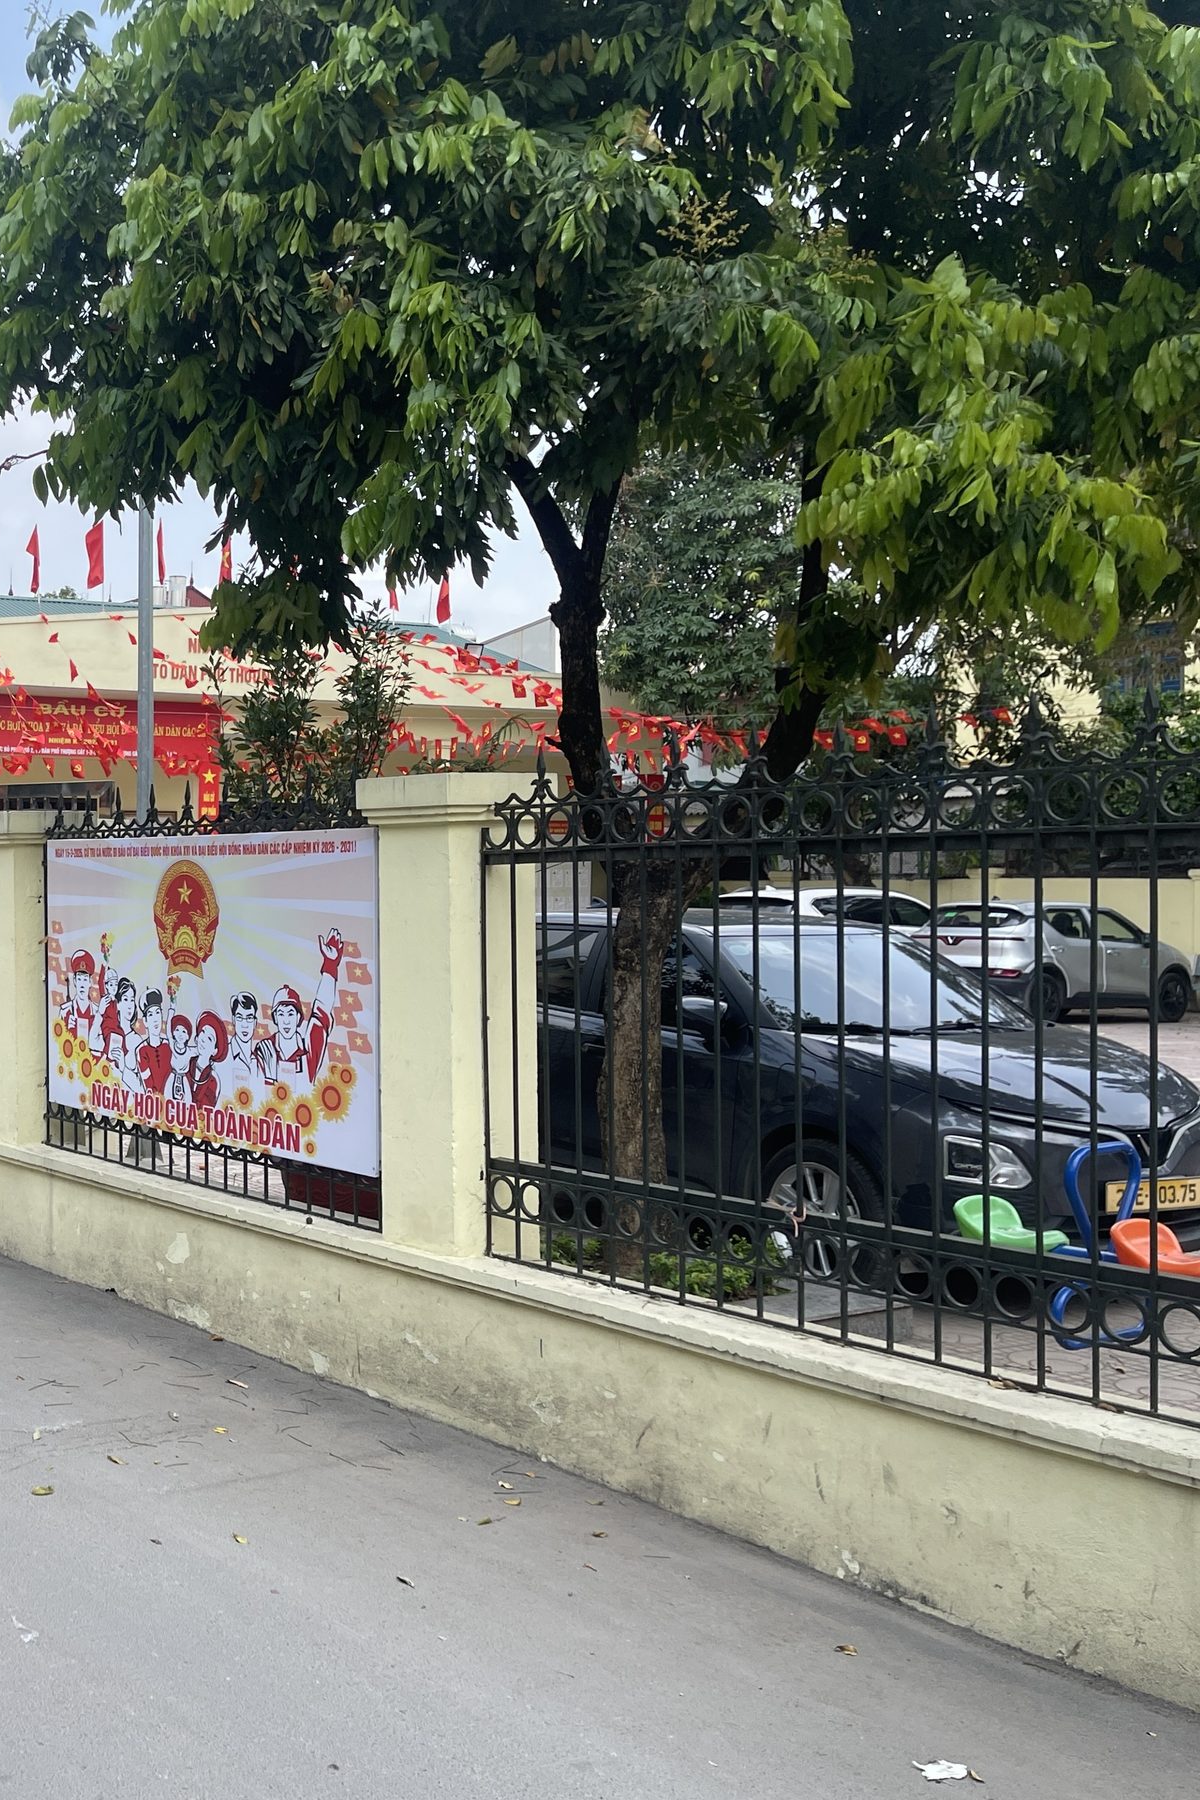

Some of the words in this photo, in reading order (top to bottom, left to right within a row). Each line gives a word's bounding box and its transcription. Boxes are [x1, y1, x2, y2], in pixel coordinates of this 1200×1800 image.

[41, 699, 87, 716] BẦU
[165, 724, 181, 737] DÂN
[269, 840, 280, 855] CÁC
[281, 838, 293, 855] CẤP
[293, 839, 312, 856] NHIỆM
[312, 839, 320, 854] KỲ
[321, 841, 335, 853] 2026
[91, 1081, 130, 1115] NGÀY
[134, 1088, 161, 1127] HỘI
[203, 1104, 253, 1144] TOÀN
[258, 1114, 301, 1153] DÂN
